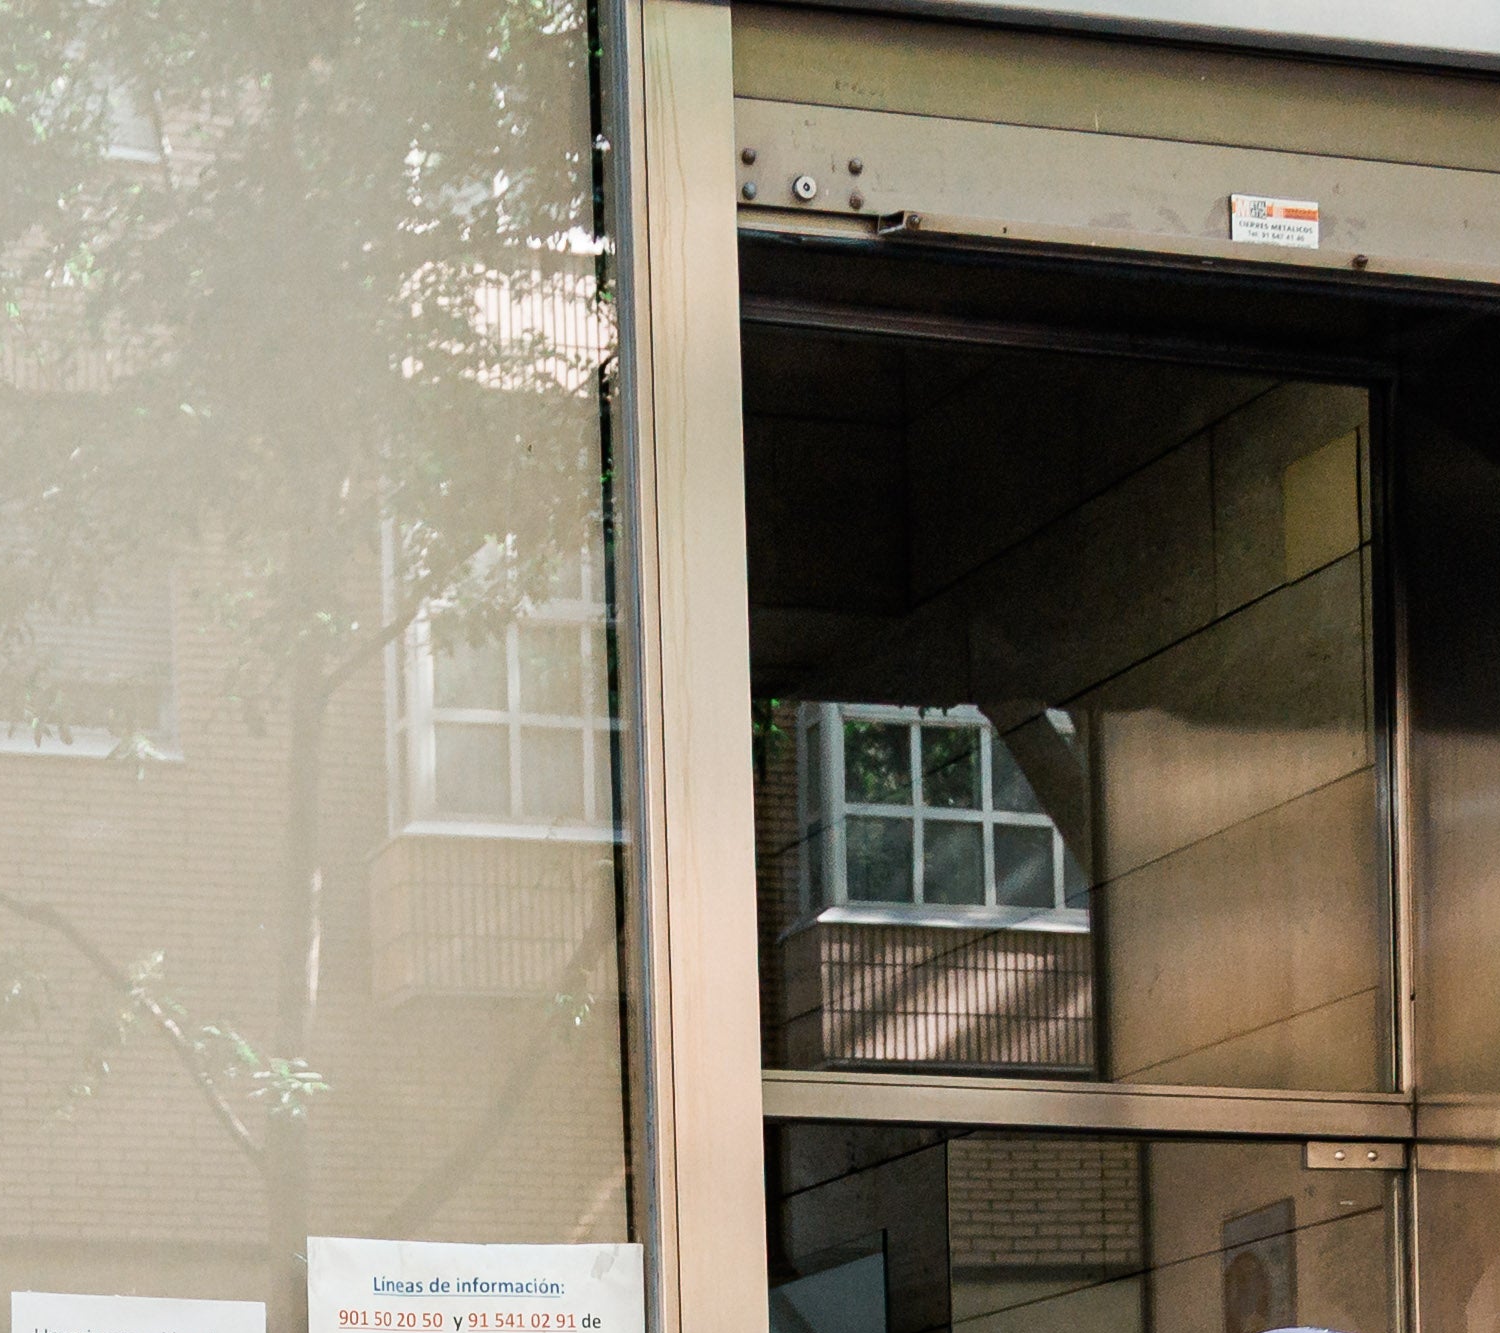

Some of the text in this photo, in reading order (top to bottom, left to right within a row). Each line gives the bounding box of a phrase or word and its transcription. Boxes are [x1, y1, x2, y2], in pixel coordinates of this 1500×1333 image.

[373, 1276, 565, 1295] Líneas de información:
[339, 1310, 602, 1331] 901 50 20 50 y 91 541 02 91 de
